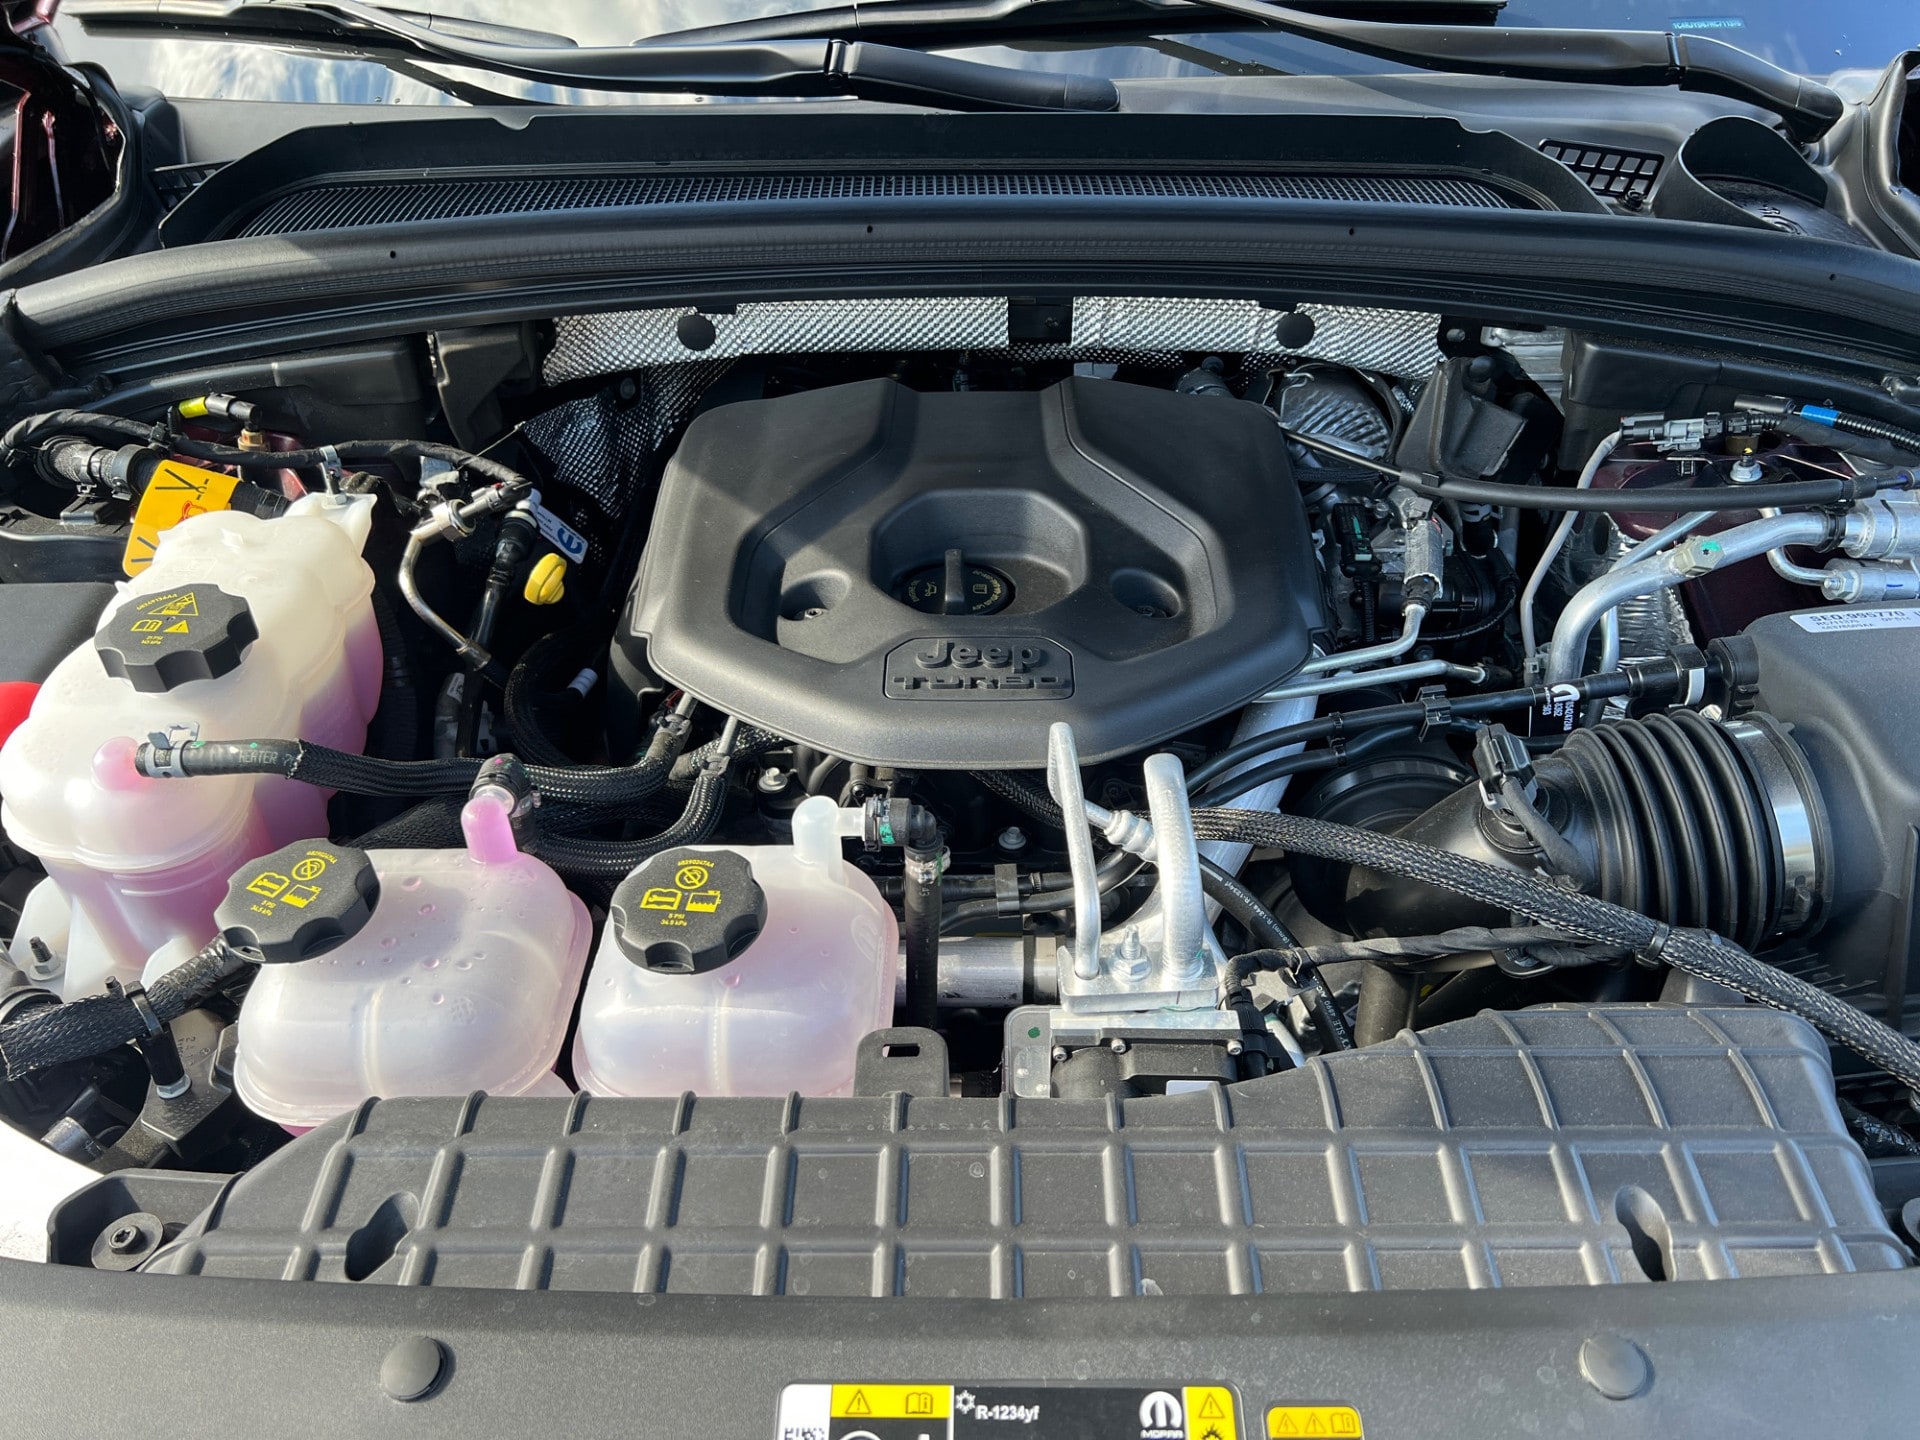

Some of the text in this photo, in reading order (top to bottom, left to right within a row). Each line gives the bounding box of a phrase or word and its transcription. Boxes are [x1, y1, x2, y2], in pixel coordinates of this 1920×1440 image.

[915, 639, 1042, 674] Jeep
[893, 676, 1070, 690] TURBO
[974, 1404, 1040, 1424] R-1234yf
